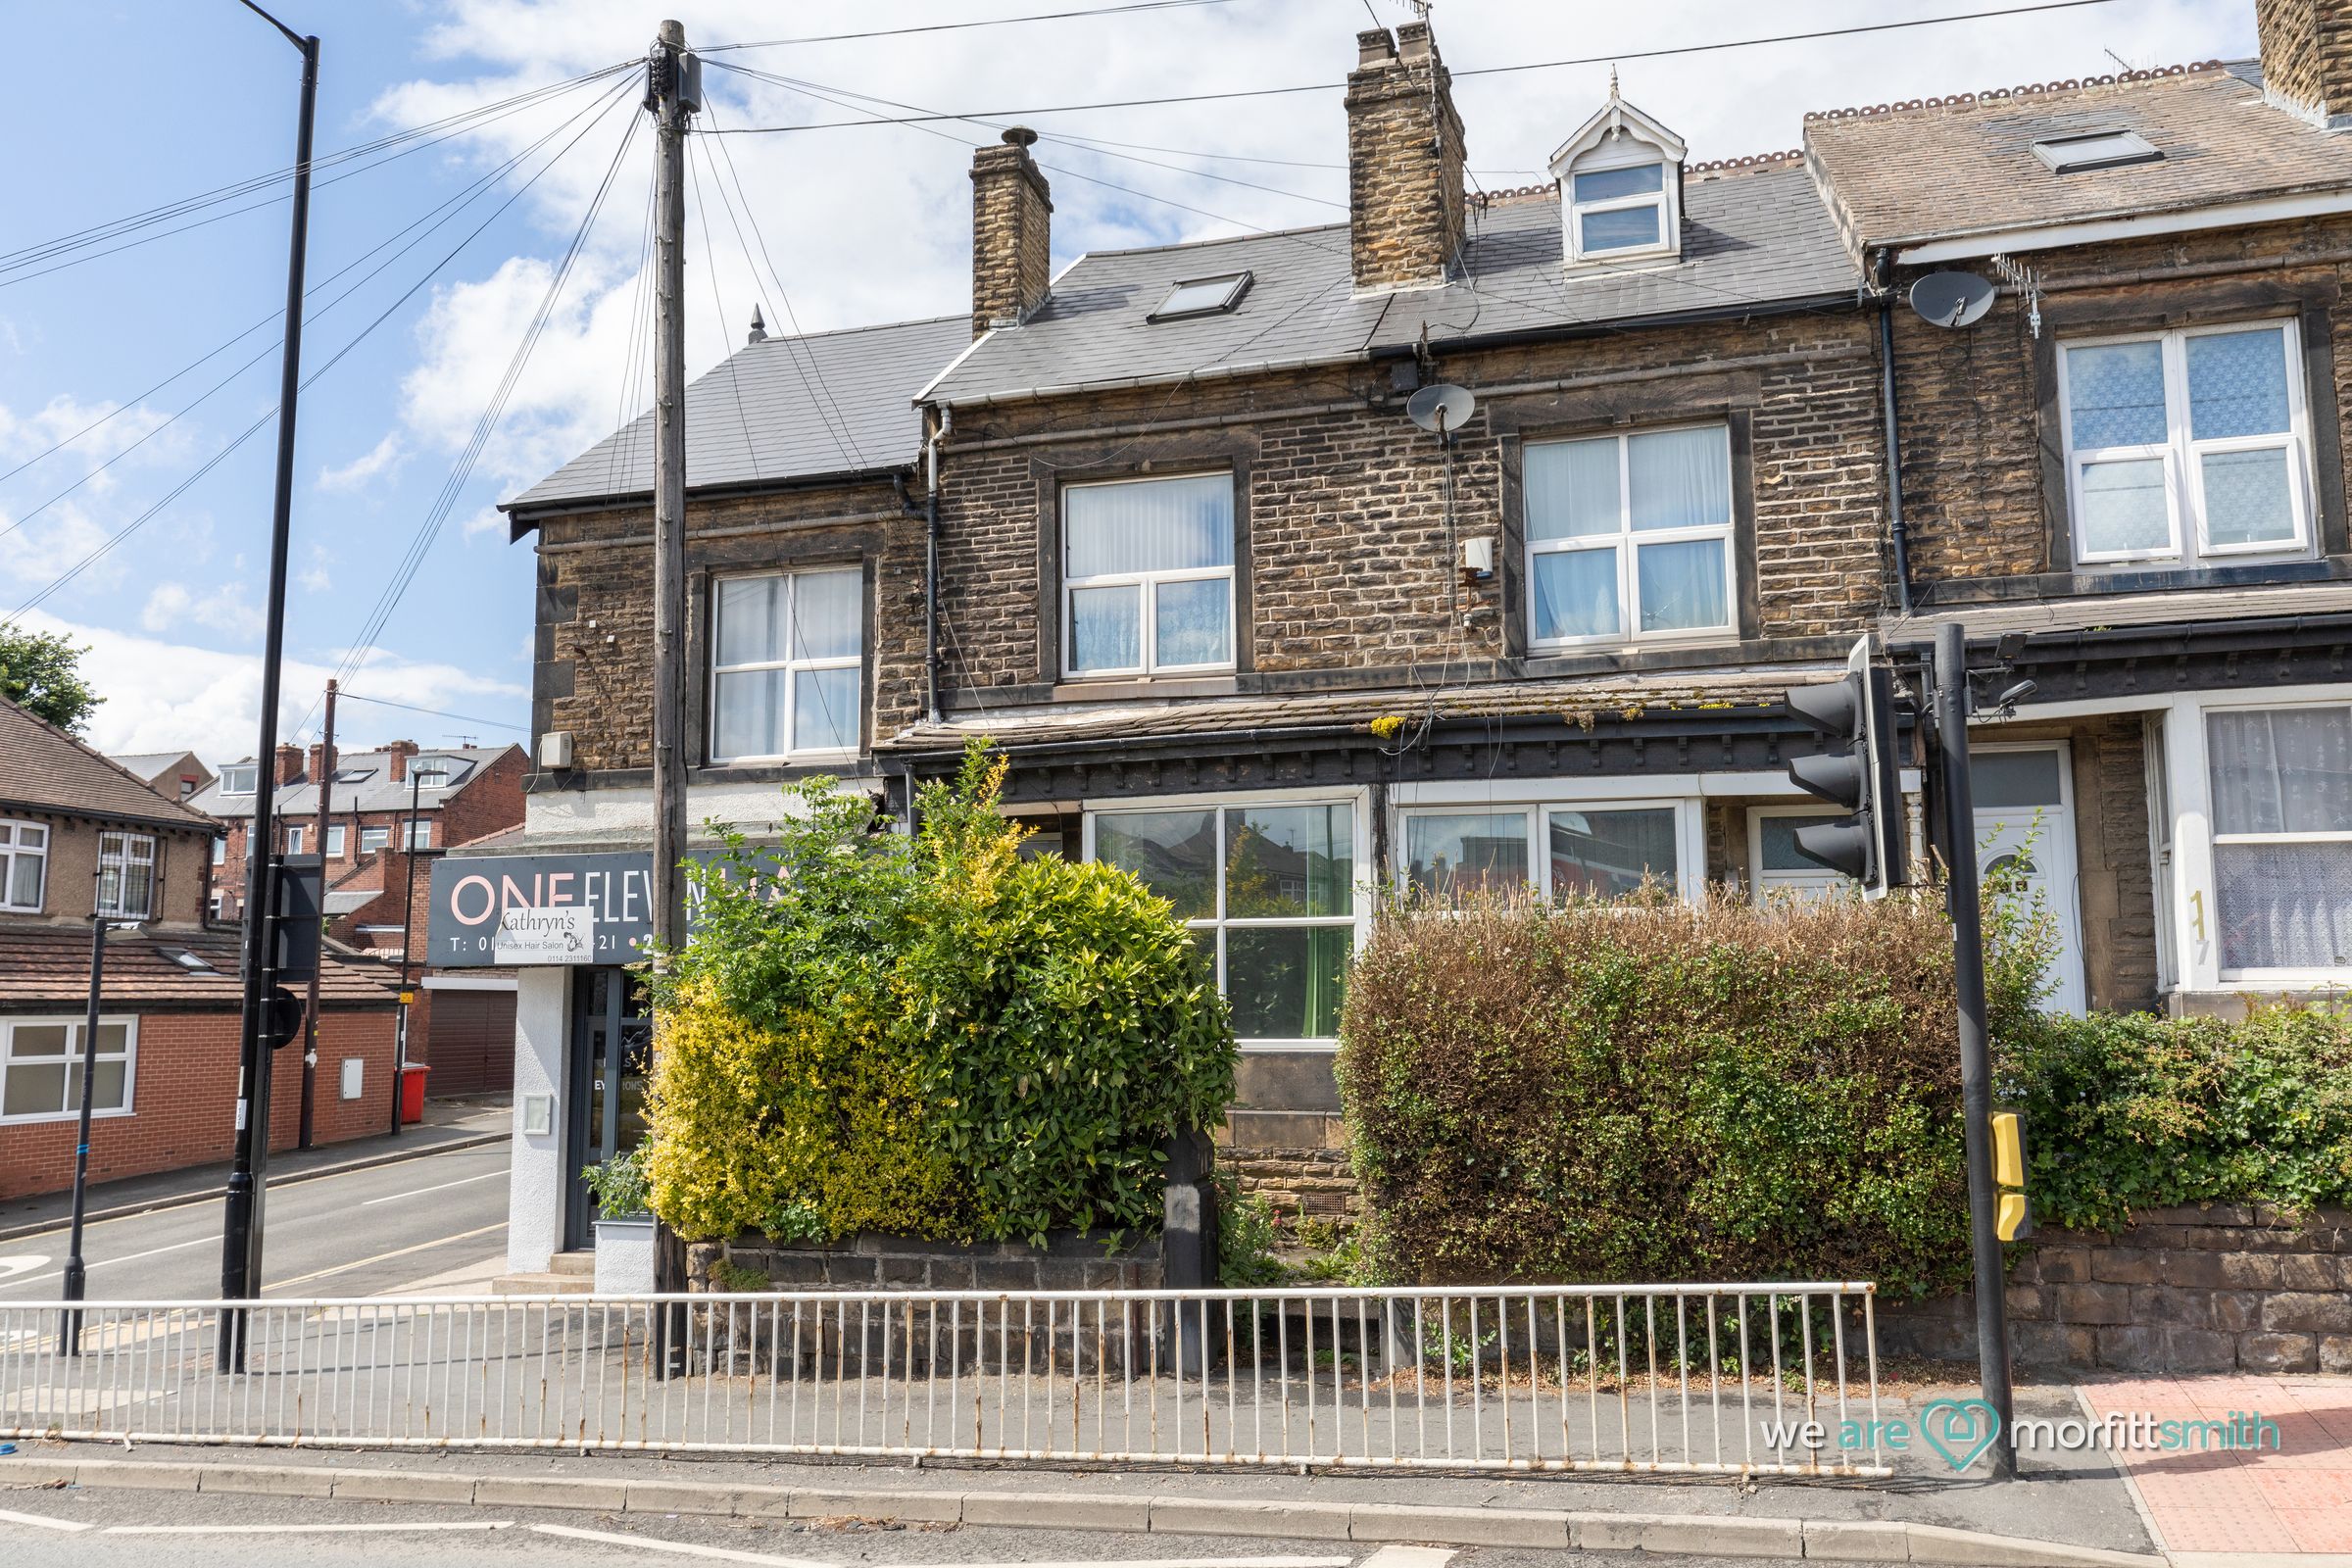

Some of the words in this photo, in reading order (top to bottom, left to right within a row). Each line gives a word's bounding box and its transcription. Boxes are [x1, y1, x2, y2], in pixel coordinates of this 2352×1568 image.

[497, 941, 523, 951] Unisex
[524, 941, 540, 951] Hair
[542, 940, 564, 951] Salon
